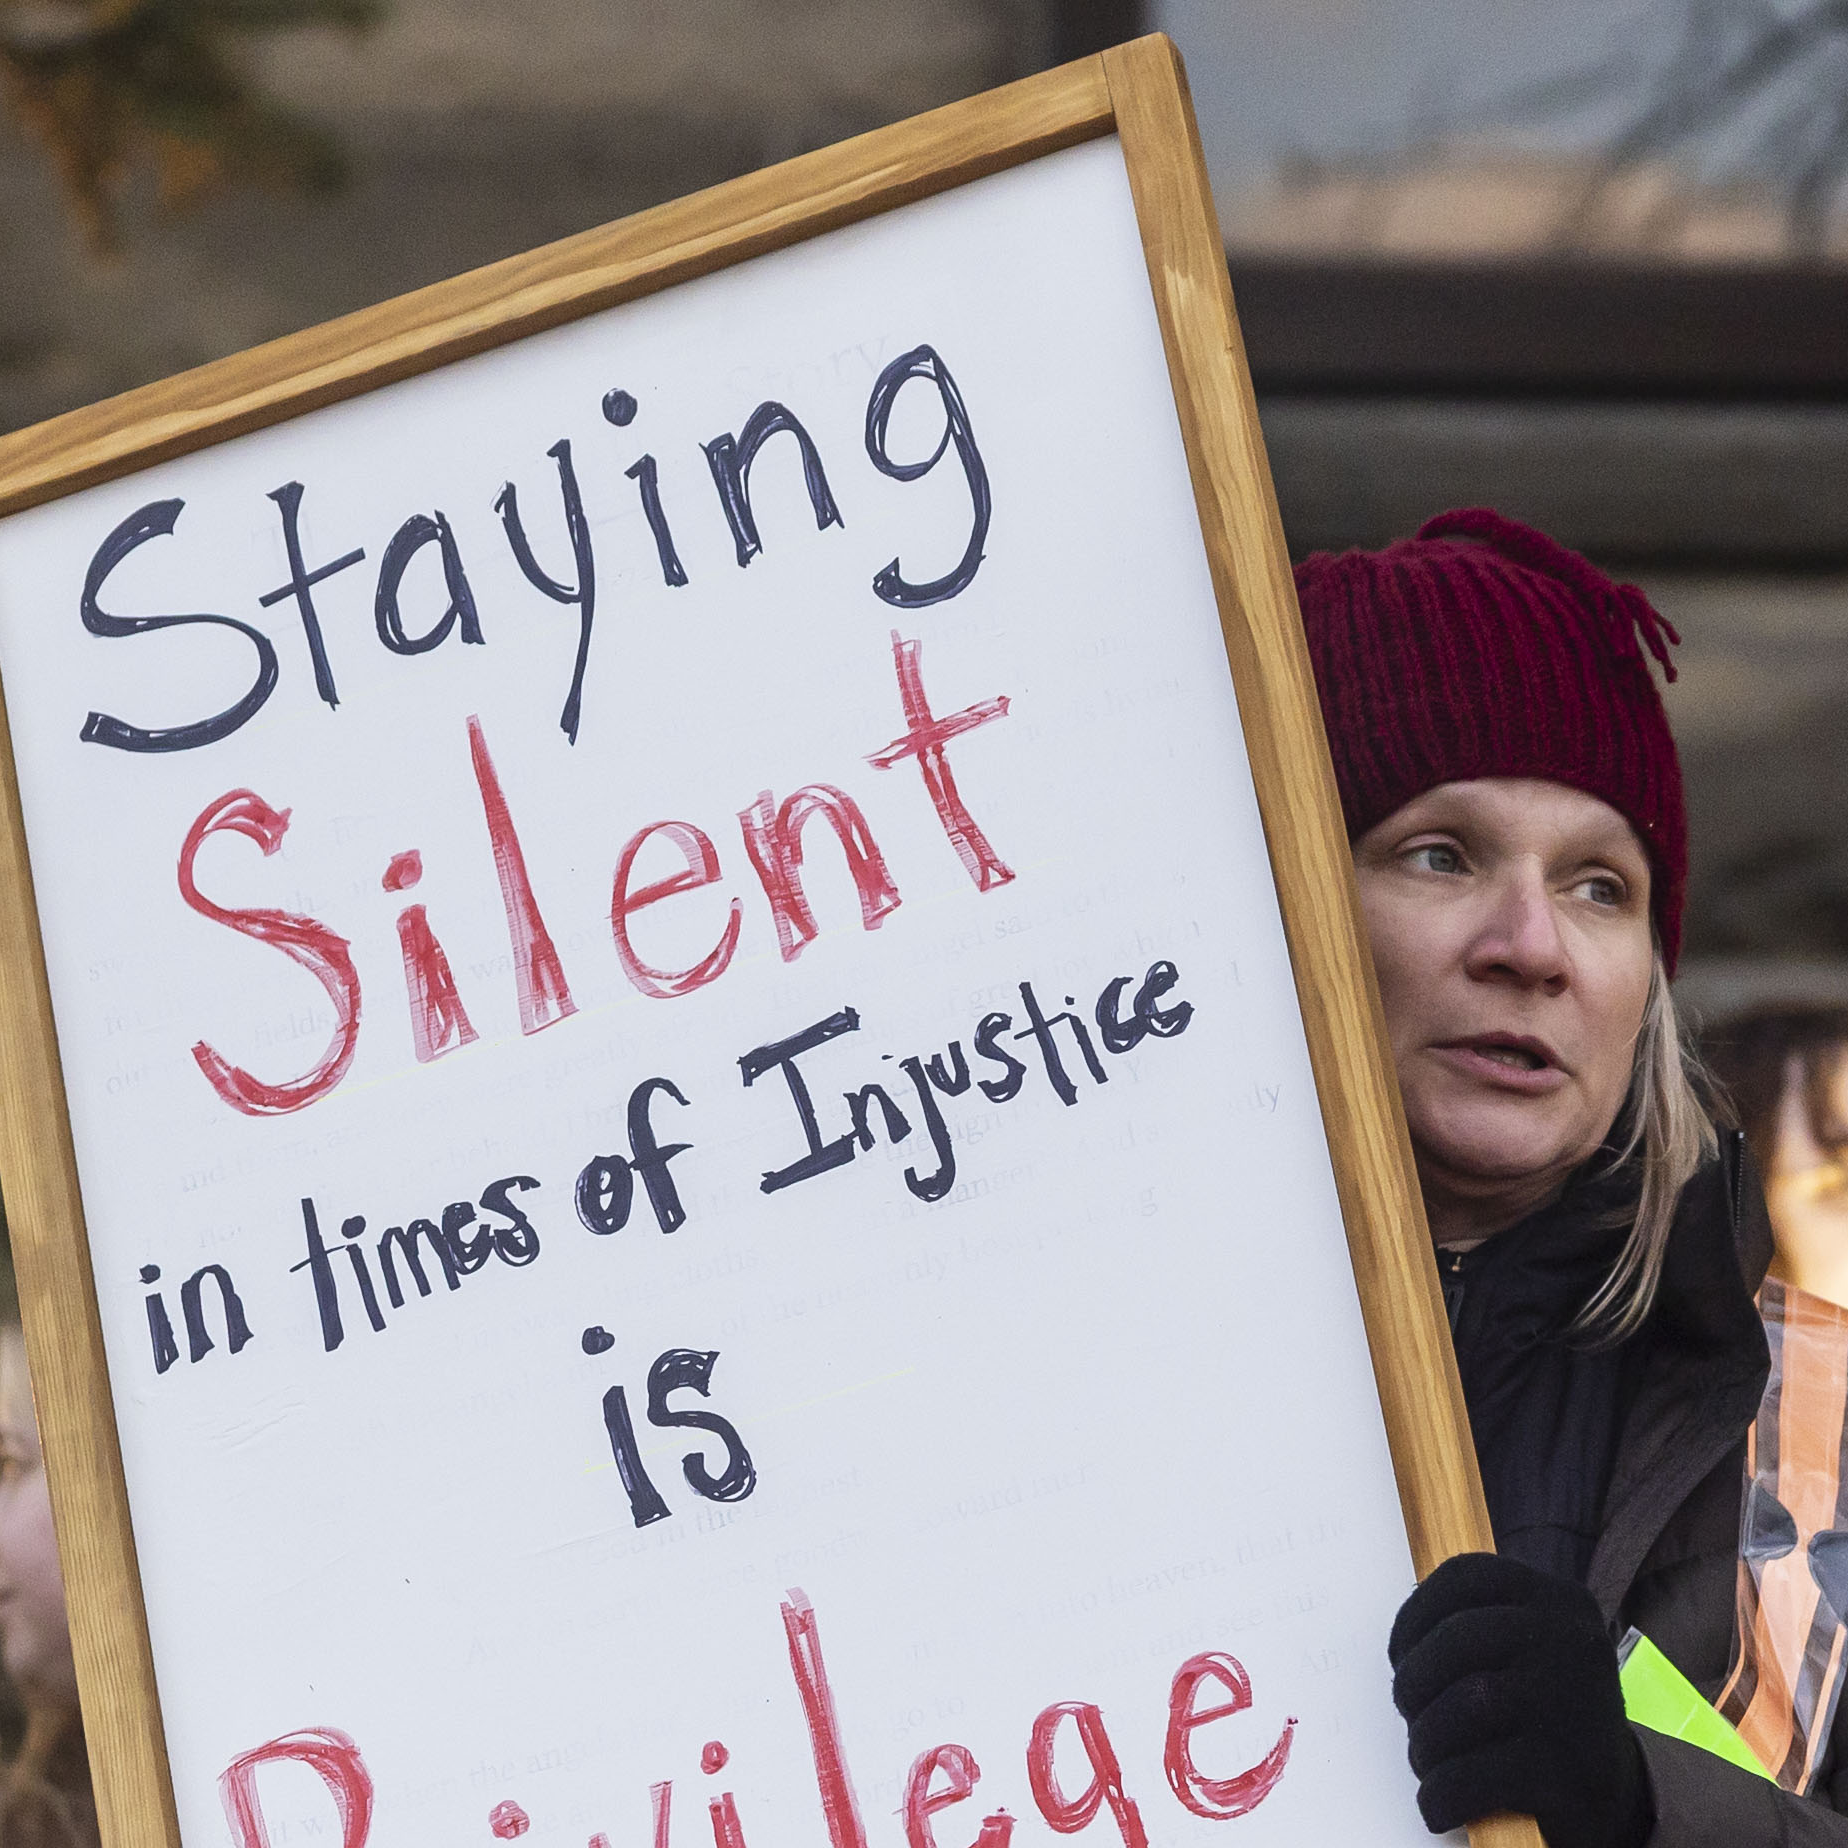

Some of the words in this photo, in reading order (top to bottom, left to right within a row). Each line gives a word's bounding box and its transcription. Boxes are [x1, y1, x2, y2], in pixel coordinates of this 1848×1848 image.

[80, 345, 991, 753] Staying
[178, 637, 1017, 1117] Silent
[140, 1264, 255, 1375] in
[289, 1175, 541, 1352] times
[578, 1077, 694, 1235] of
[737, 960, 1195, 1203] Injustice
[581, 1326, 757, 1529] is
